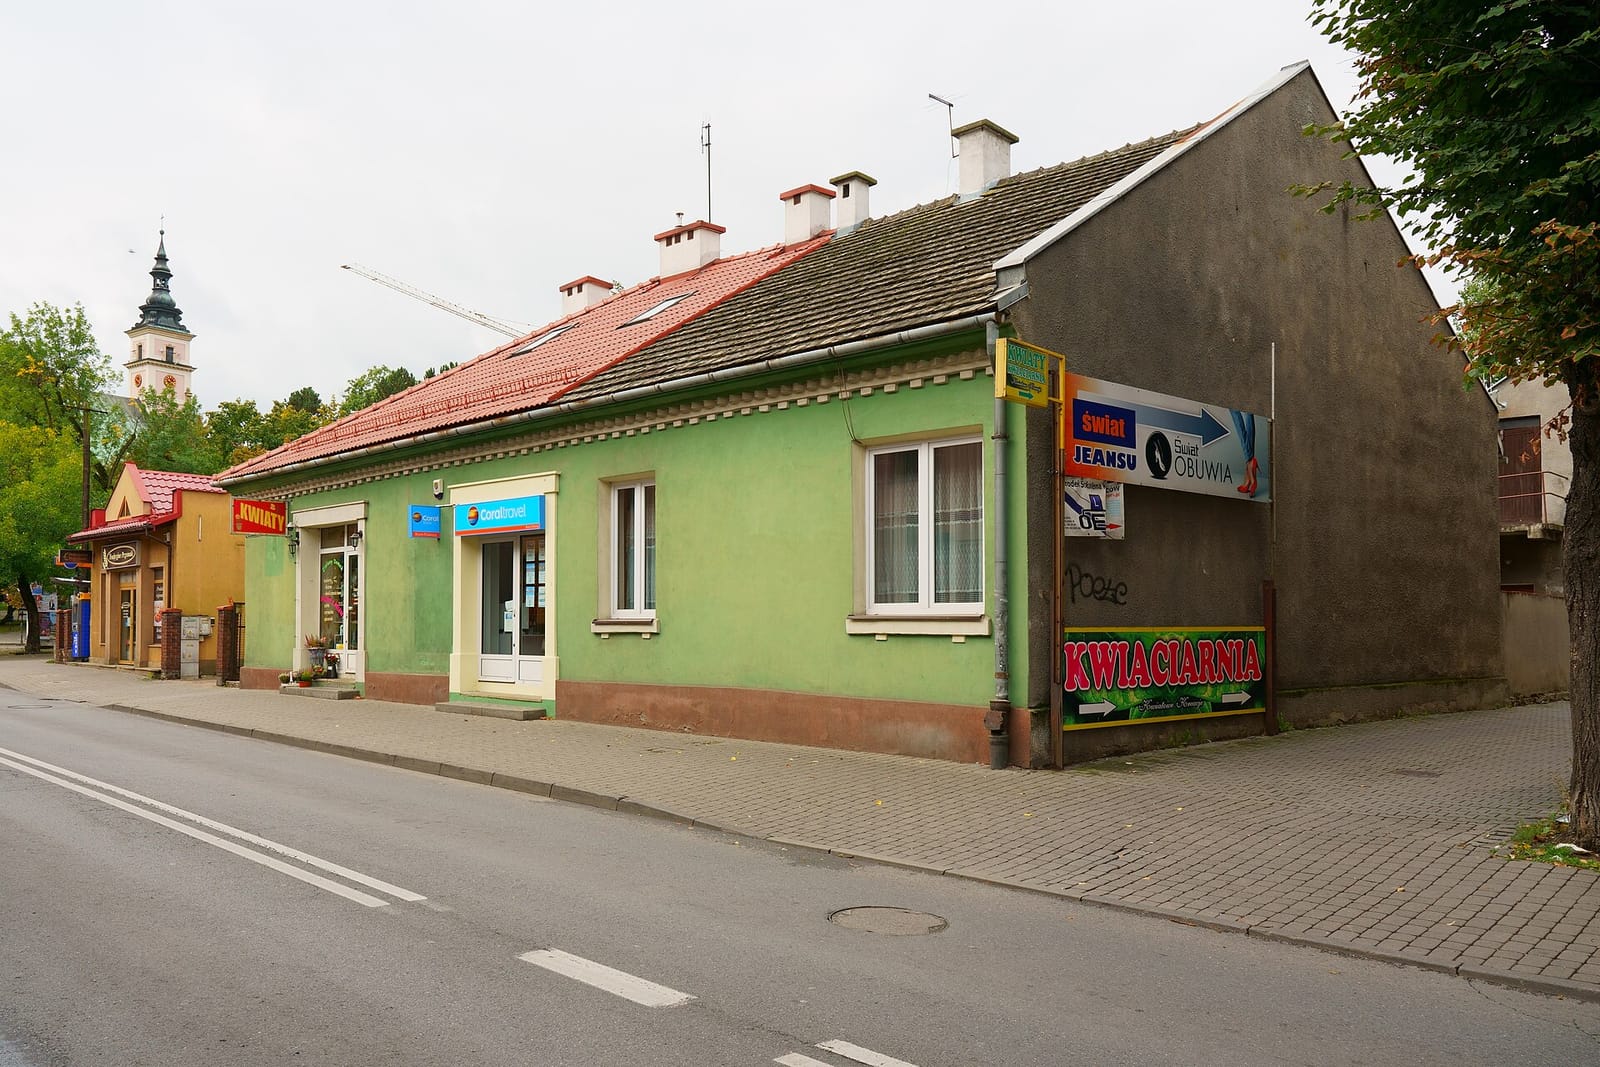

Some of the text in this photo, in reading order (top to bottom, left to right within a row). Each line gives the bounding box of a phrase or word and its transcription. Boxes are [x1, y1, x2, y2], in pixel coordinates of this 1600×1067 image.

[1008, 344, 1046, 370] KWIATY
[1074, 445, 1137, 471] JEANSU
[1175, 436, 1199, 457] Świat
[1175, 456, 1233, 484] OBUWIA
[240, 502, 285, 532] KWIATY
[1064, 639, 1262, 692] KWIACIARNIA
